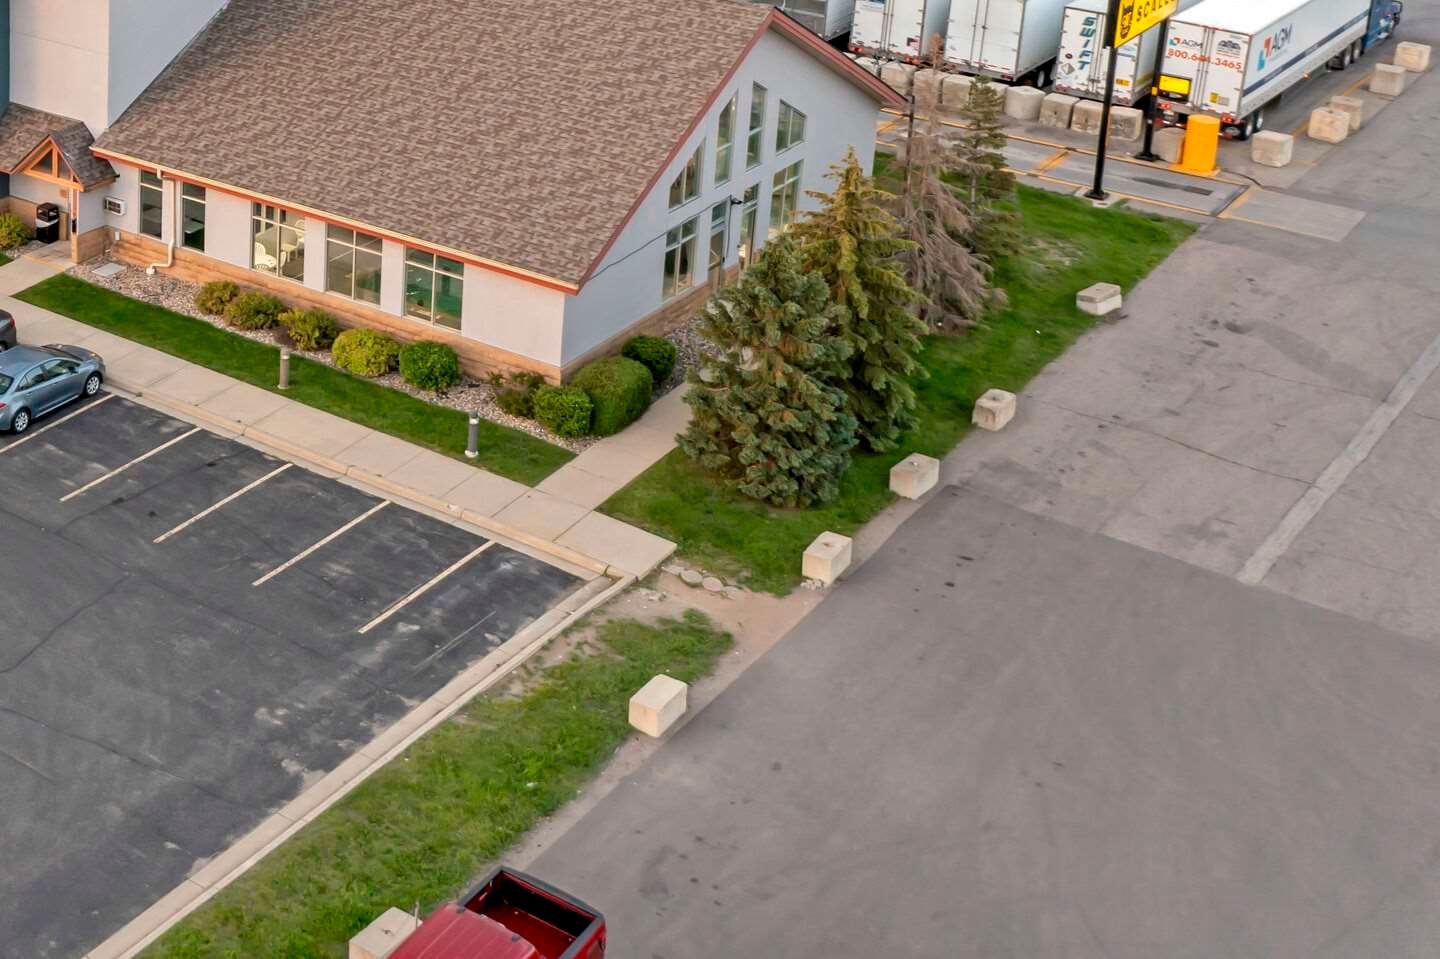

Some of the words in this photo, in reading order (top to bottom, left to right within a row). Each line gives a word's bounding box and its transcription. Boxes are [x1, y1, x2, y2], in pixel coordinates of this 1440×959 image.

[1077, 16, 1097, 71] SWIFT
[1181, 39, 1204, 49] AGM
[1271, 24, 1293, 51] AGM
